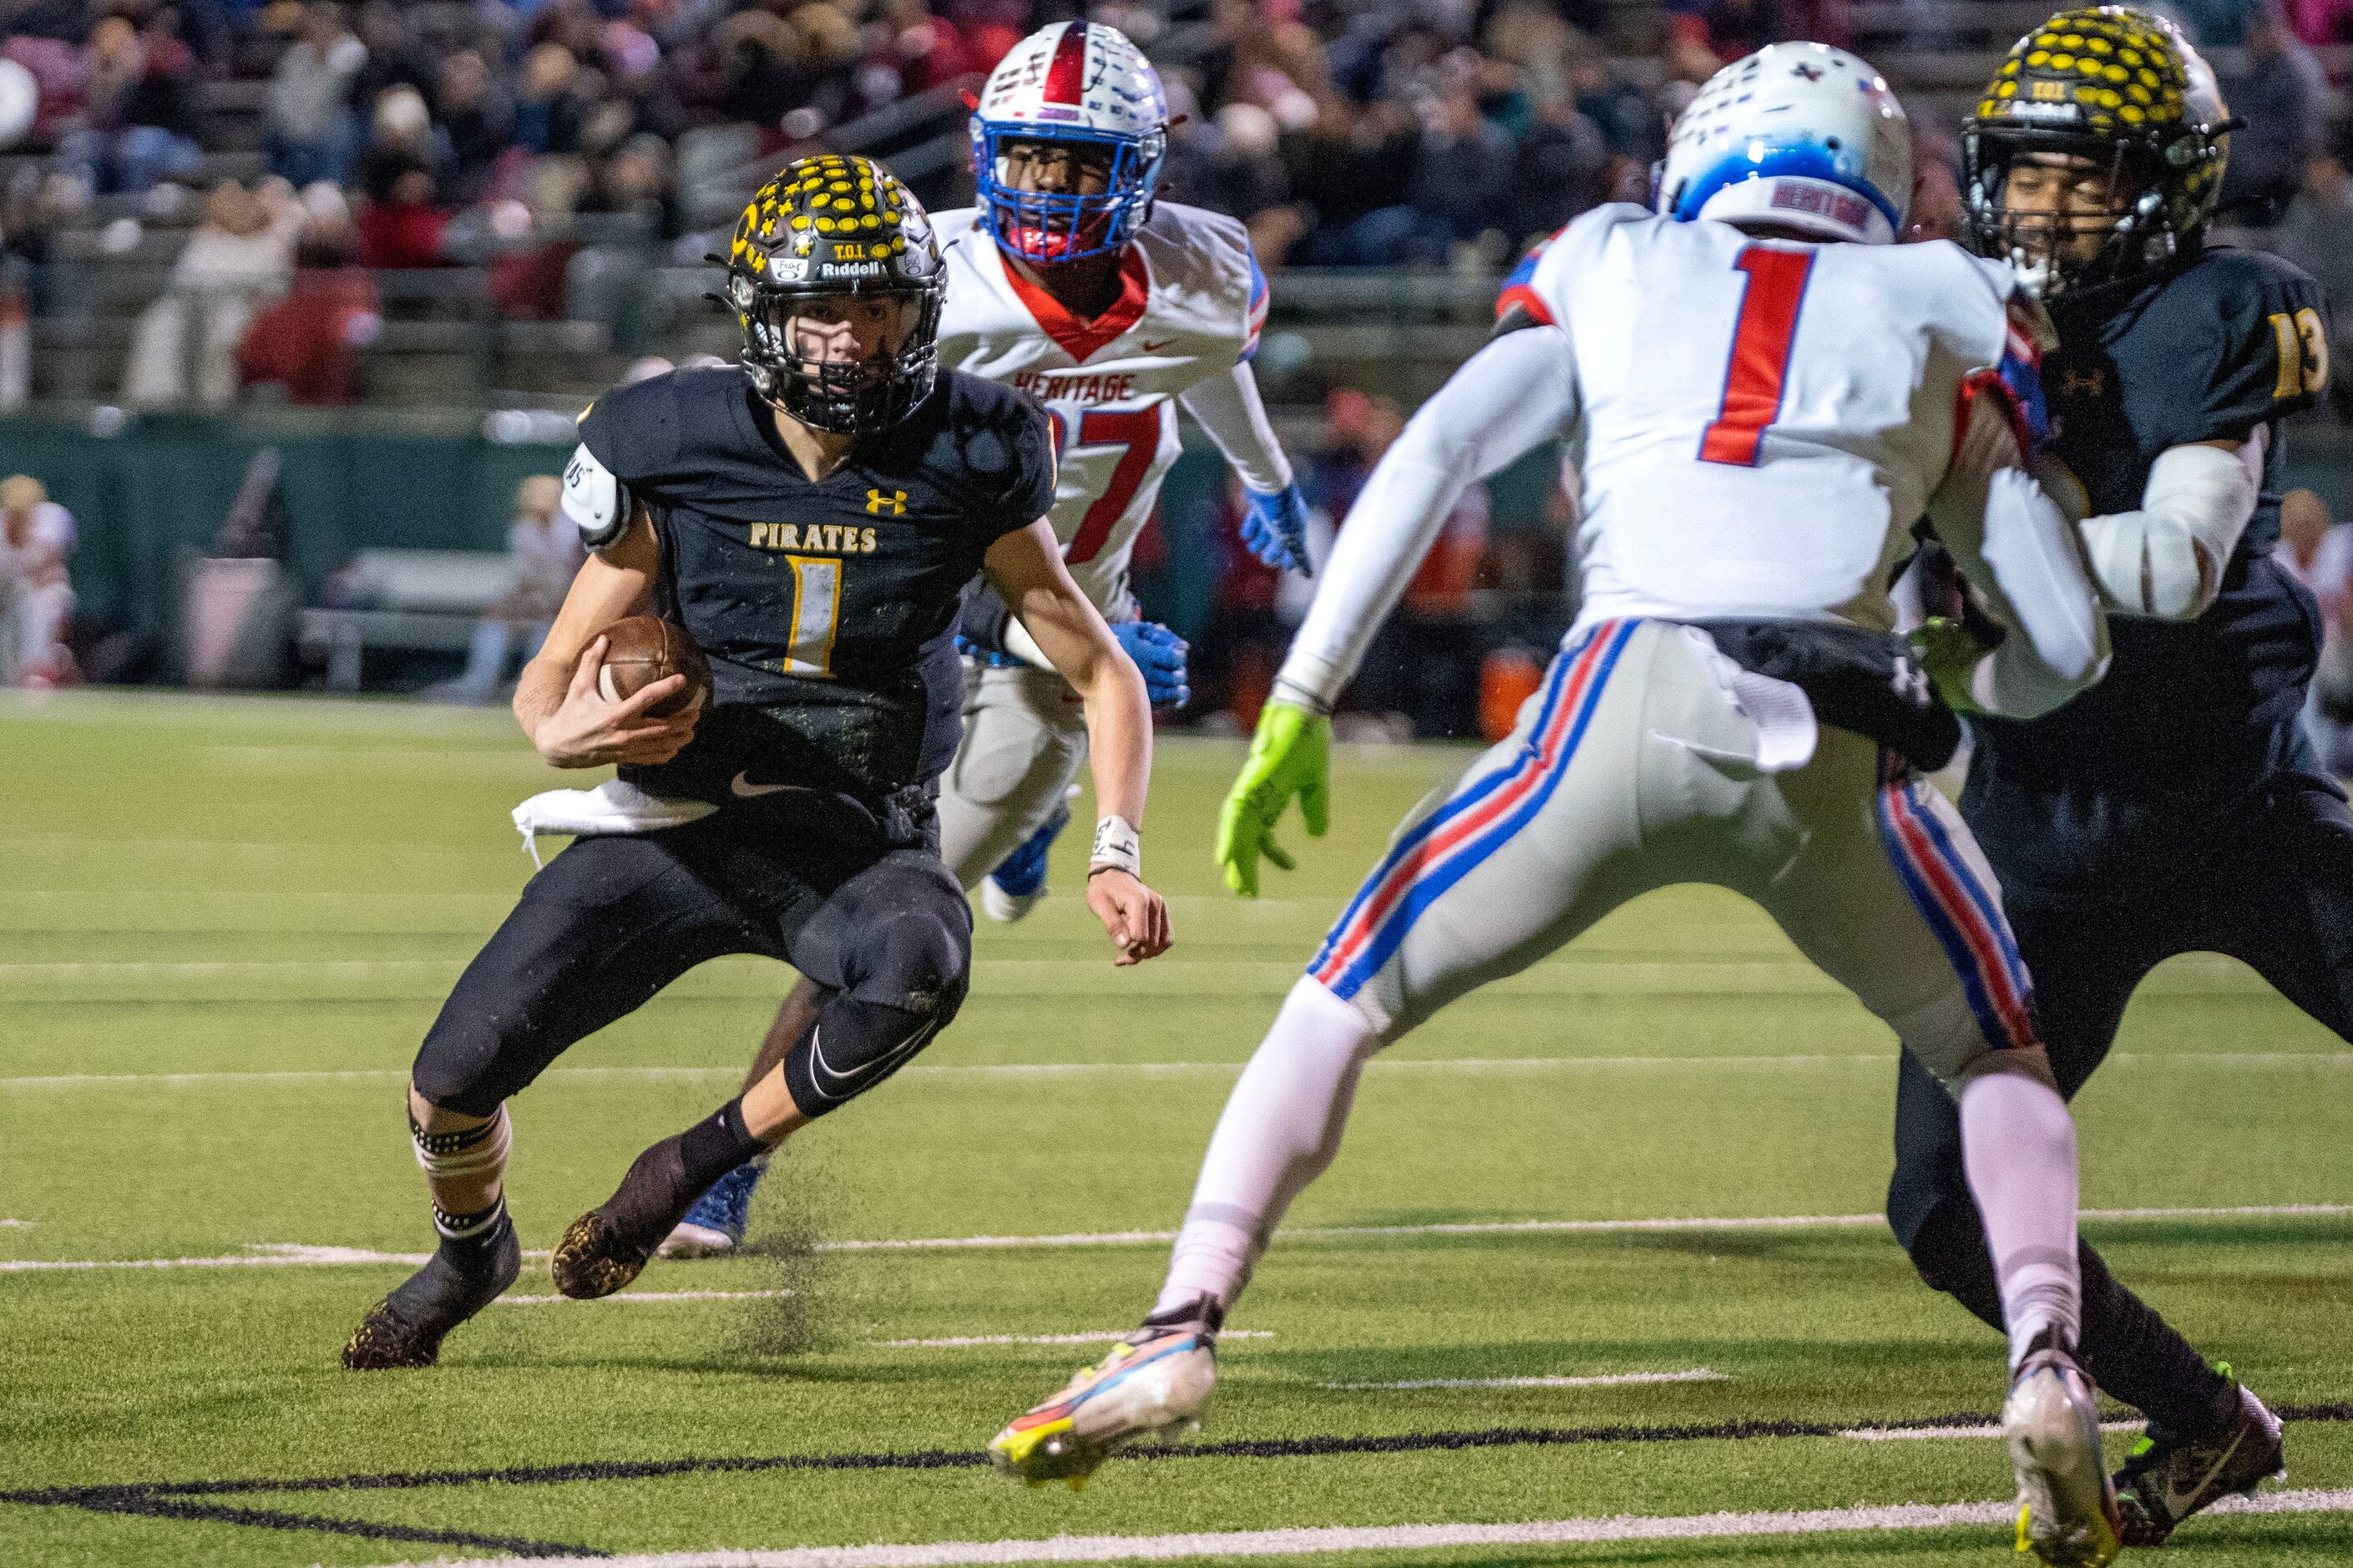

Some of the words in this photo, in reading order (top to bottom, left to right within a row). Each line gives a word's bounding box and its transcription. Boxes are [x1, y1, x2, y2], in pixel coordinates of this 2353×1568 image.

[779, 260, 802, 272] Fear
[822, 261, 879, 276] Riddell
[1695, 247, 1819, 468] 1
[2267, 306, 2330, 398] 13
[1015, 373, 1136, 401] HERITAGE
[1047, 402, 1162, 566] 7
[749, 523, 877, 554] PIRATES
[783, 555, 842, 677] 1
